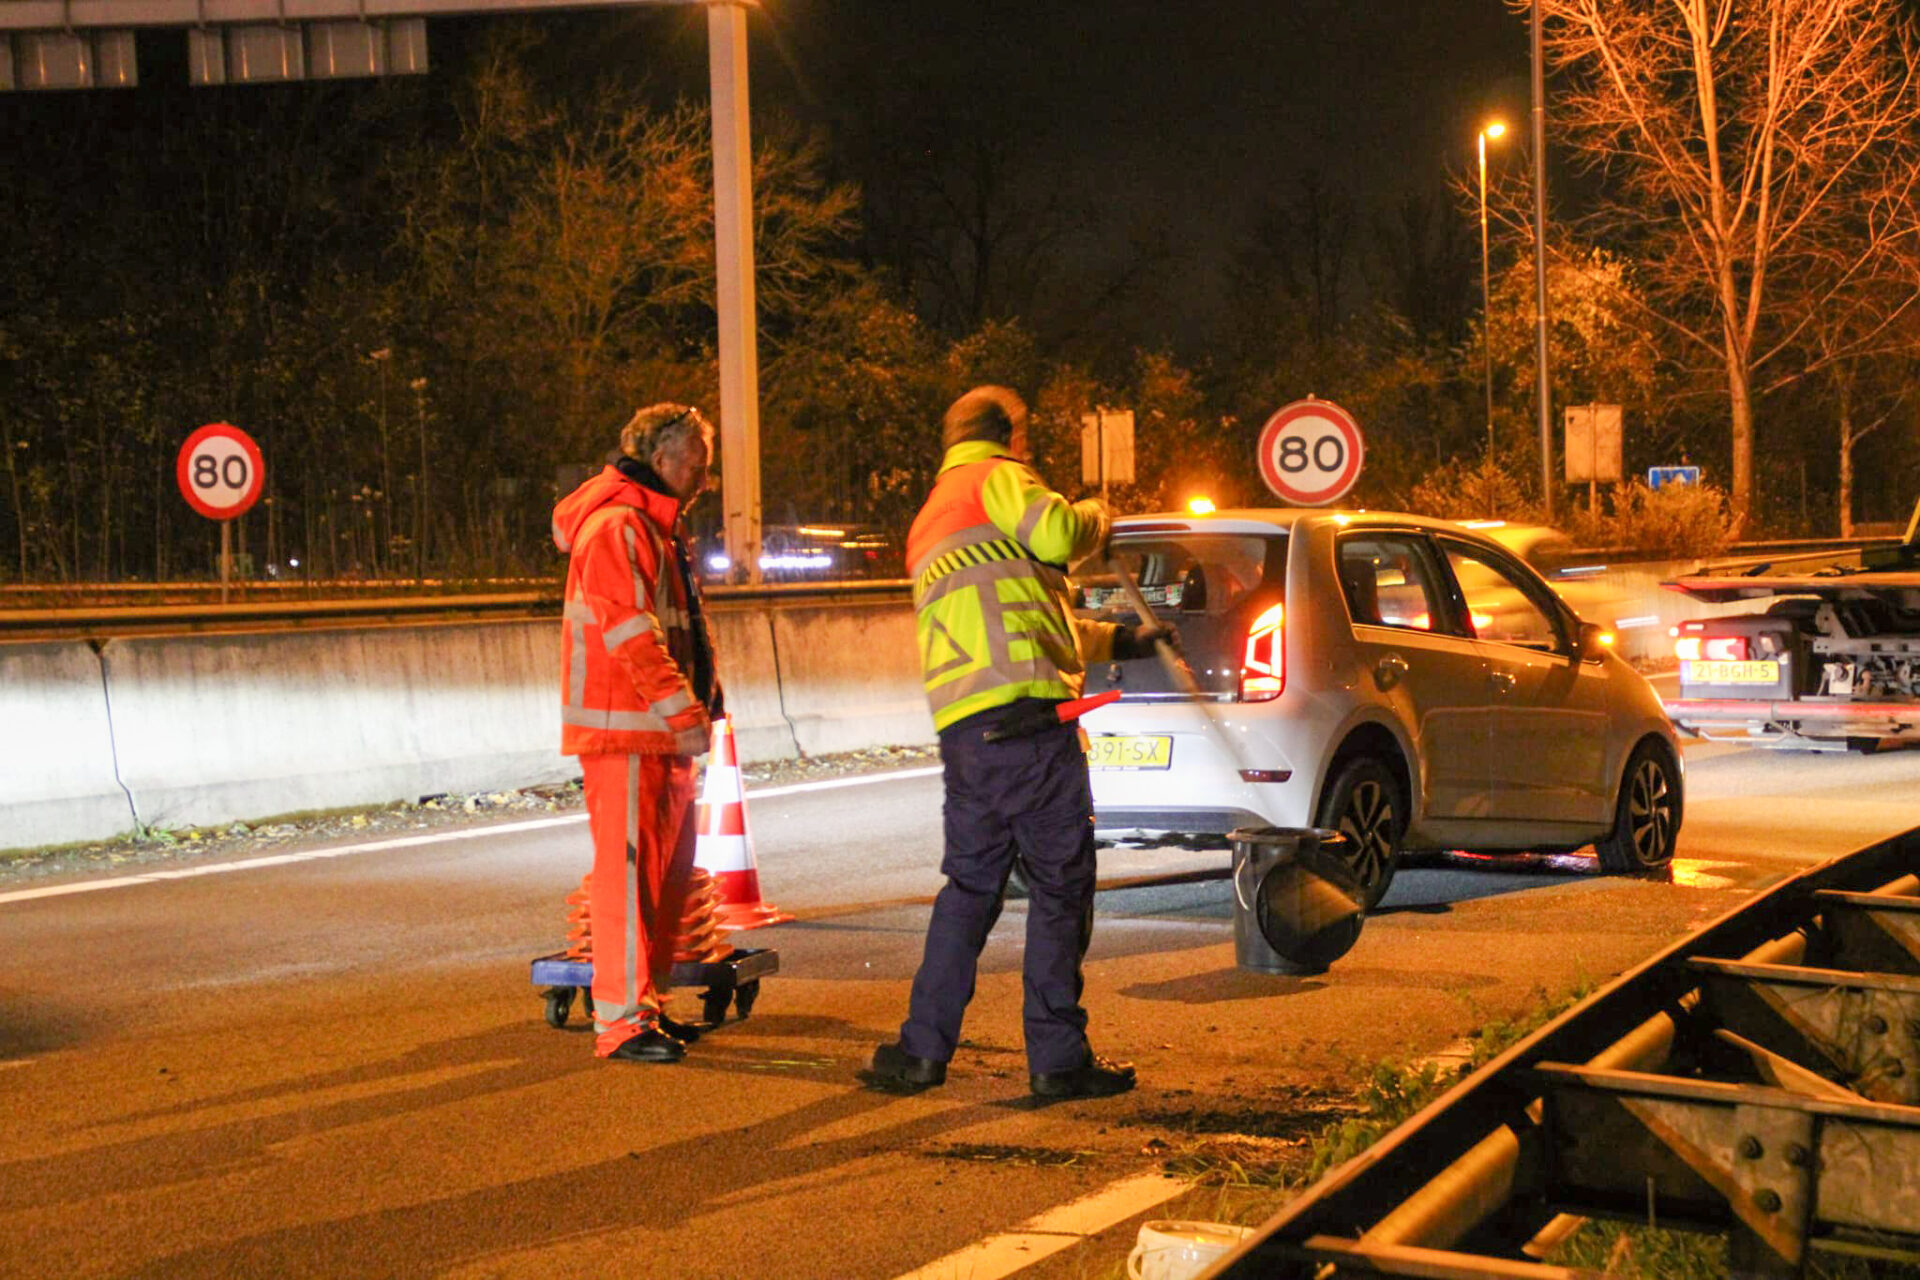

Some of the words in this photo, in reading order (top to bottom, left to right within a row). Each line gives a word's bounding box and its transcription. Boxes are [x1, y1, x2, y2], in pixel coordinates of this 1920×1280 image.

[194, 454, 247, 489] 80
[1279, 435, 1344, 473] 80
[1696, 663, 1770, 678] 21-BGH-5
